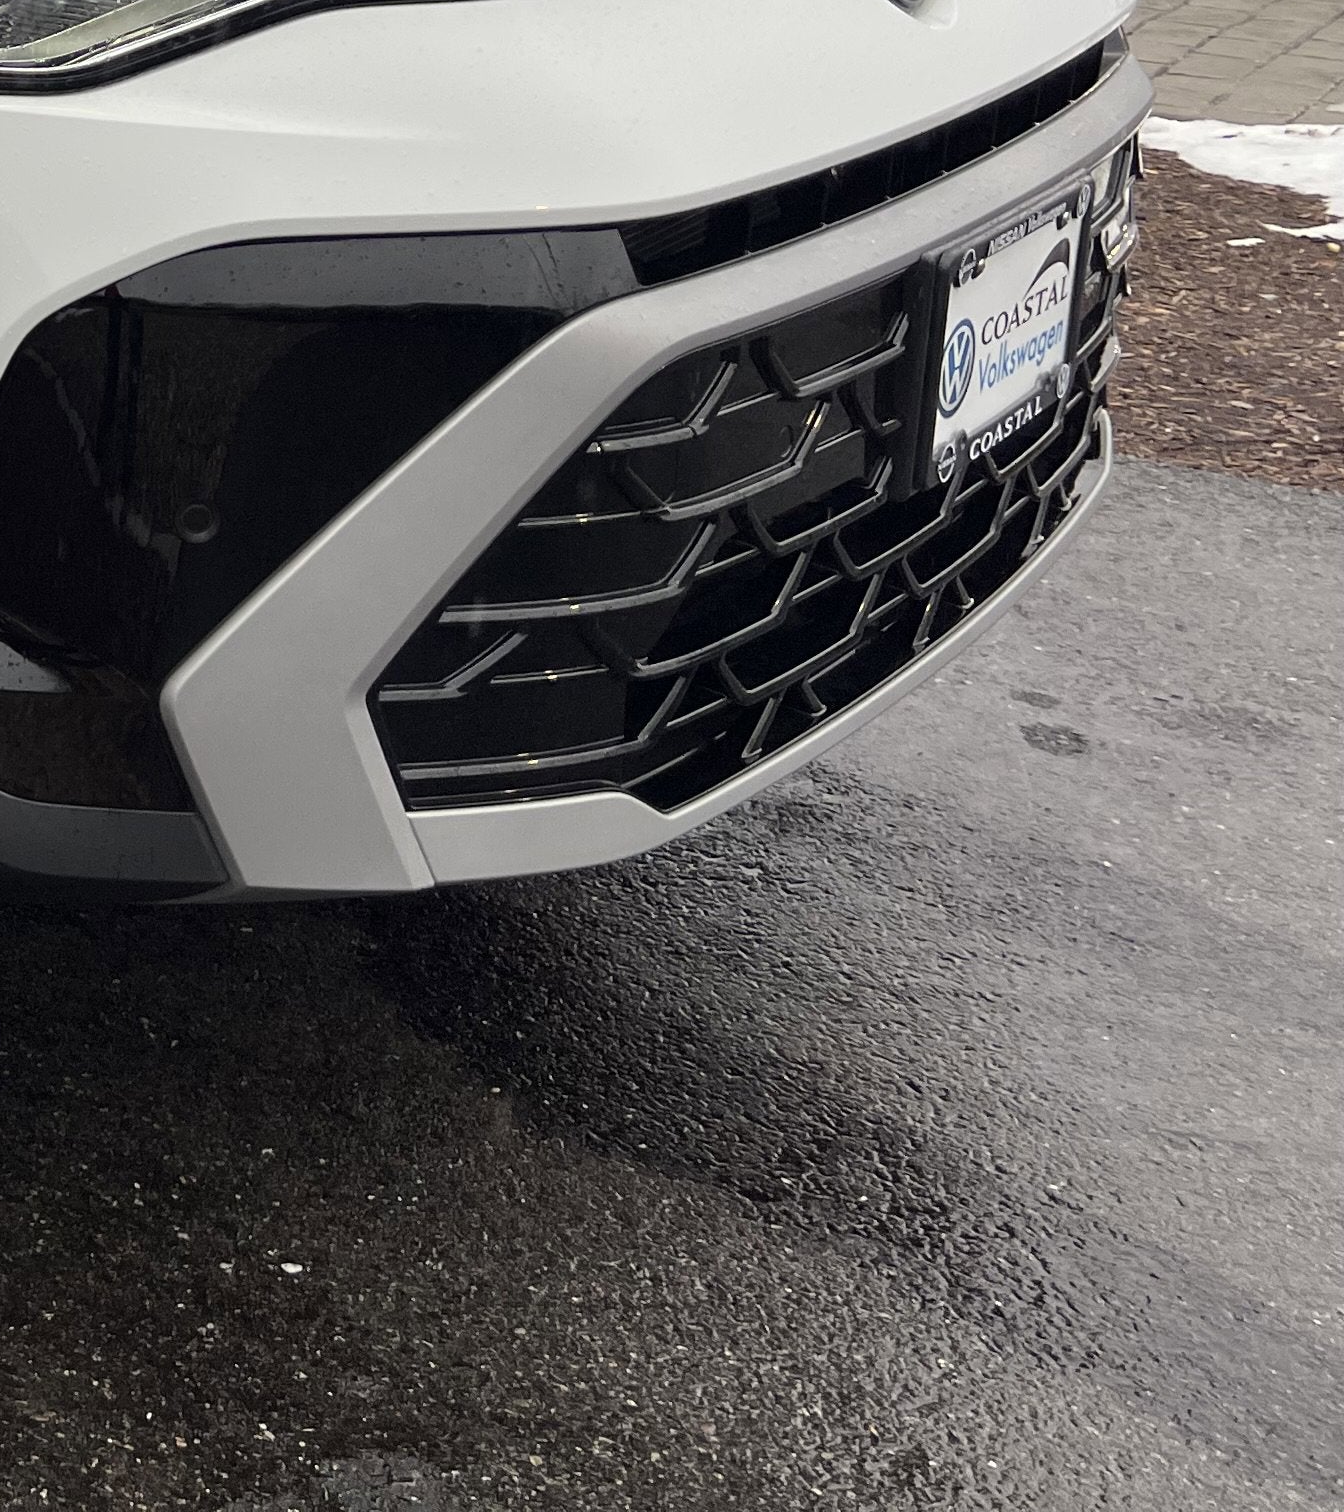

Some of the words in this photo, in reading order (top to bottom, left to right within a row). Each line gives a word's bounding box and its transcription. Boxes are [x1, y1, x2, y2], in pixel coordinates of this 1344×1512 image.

[981, 274, 1069, 346] COASTAL
[978, 320, 1064, 394] Volkswagen
[969, 395, 1043, 461] COASTAL
